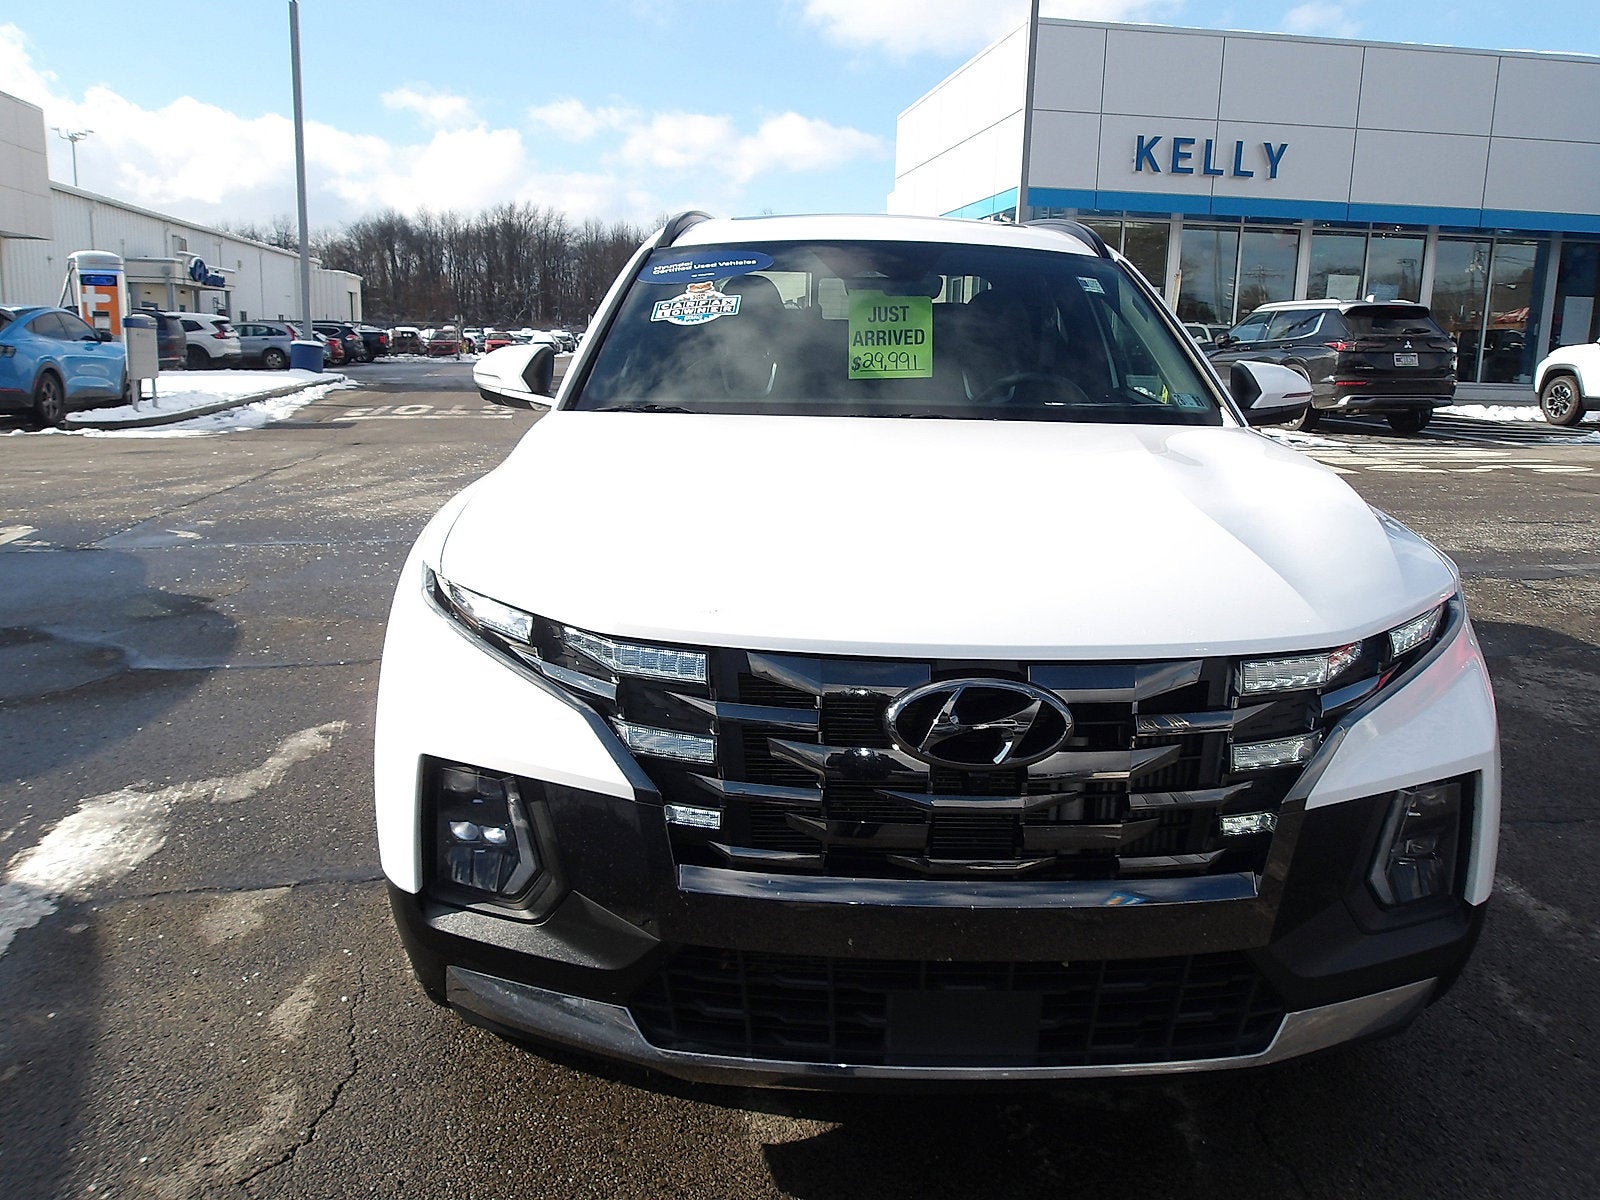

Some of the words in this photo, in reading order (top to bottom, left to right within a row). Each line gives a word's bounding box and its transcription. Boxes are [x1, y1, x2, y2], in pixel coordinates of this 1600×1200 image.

[1135, 134, 1289, 179] KELLY
[694, 262, 717, 270] Used
[717, 259, 757, 267] Vehicles
[659, 300, 733, 310] CARFAX
[867, 305, 910, 323] JUST
[852, 328, 925, 347] ARRIVED
[851, 351, 918, 372] $29,991
